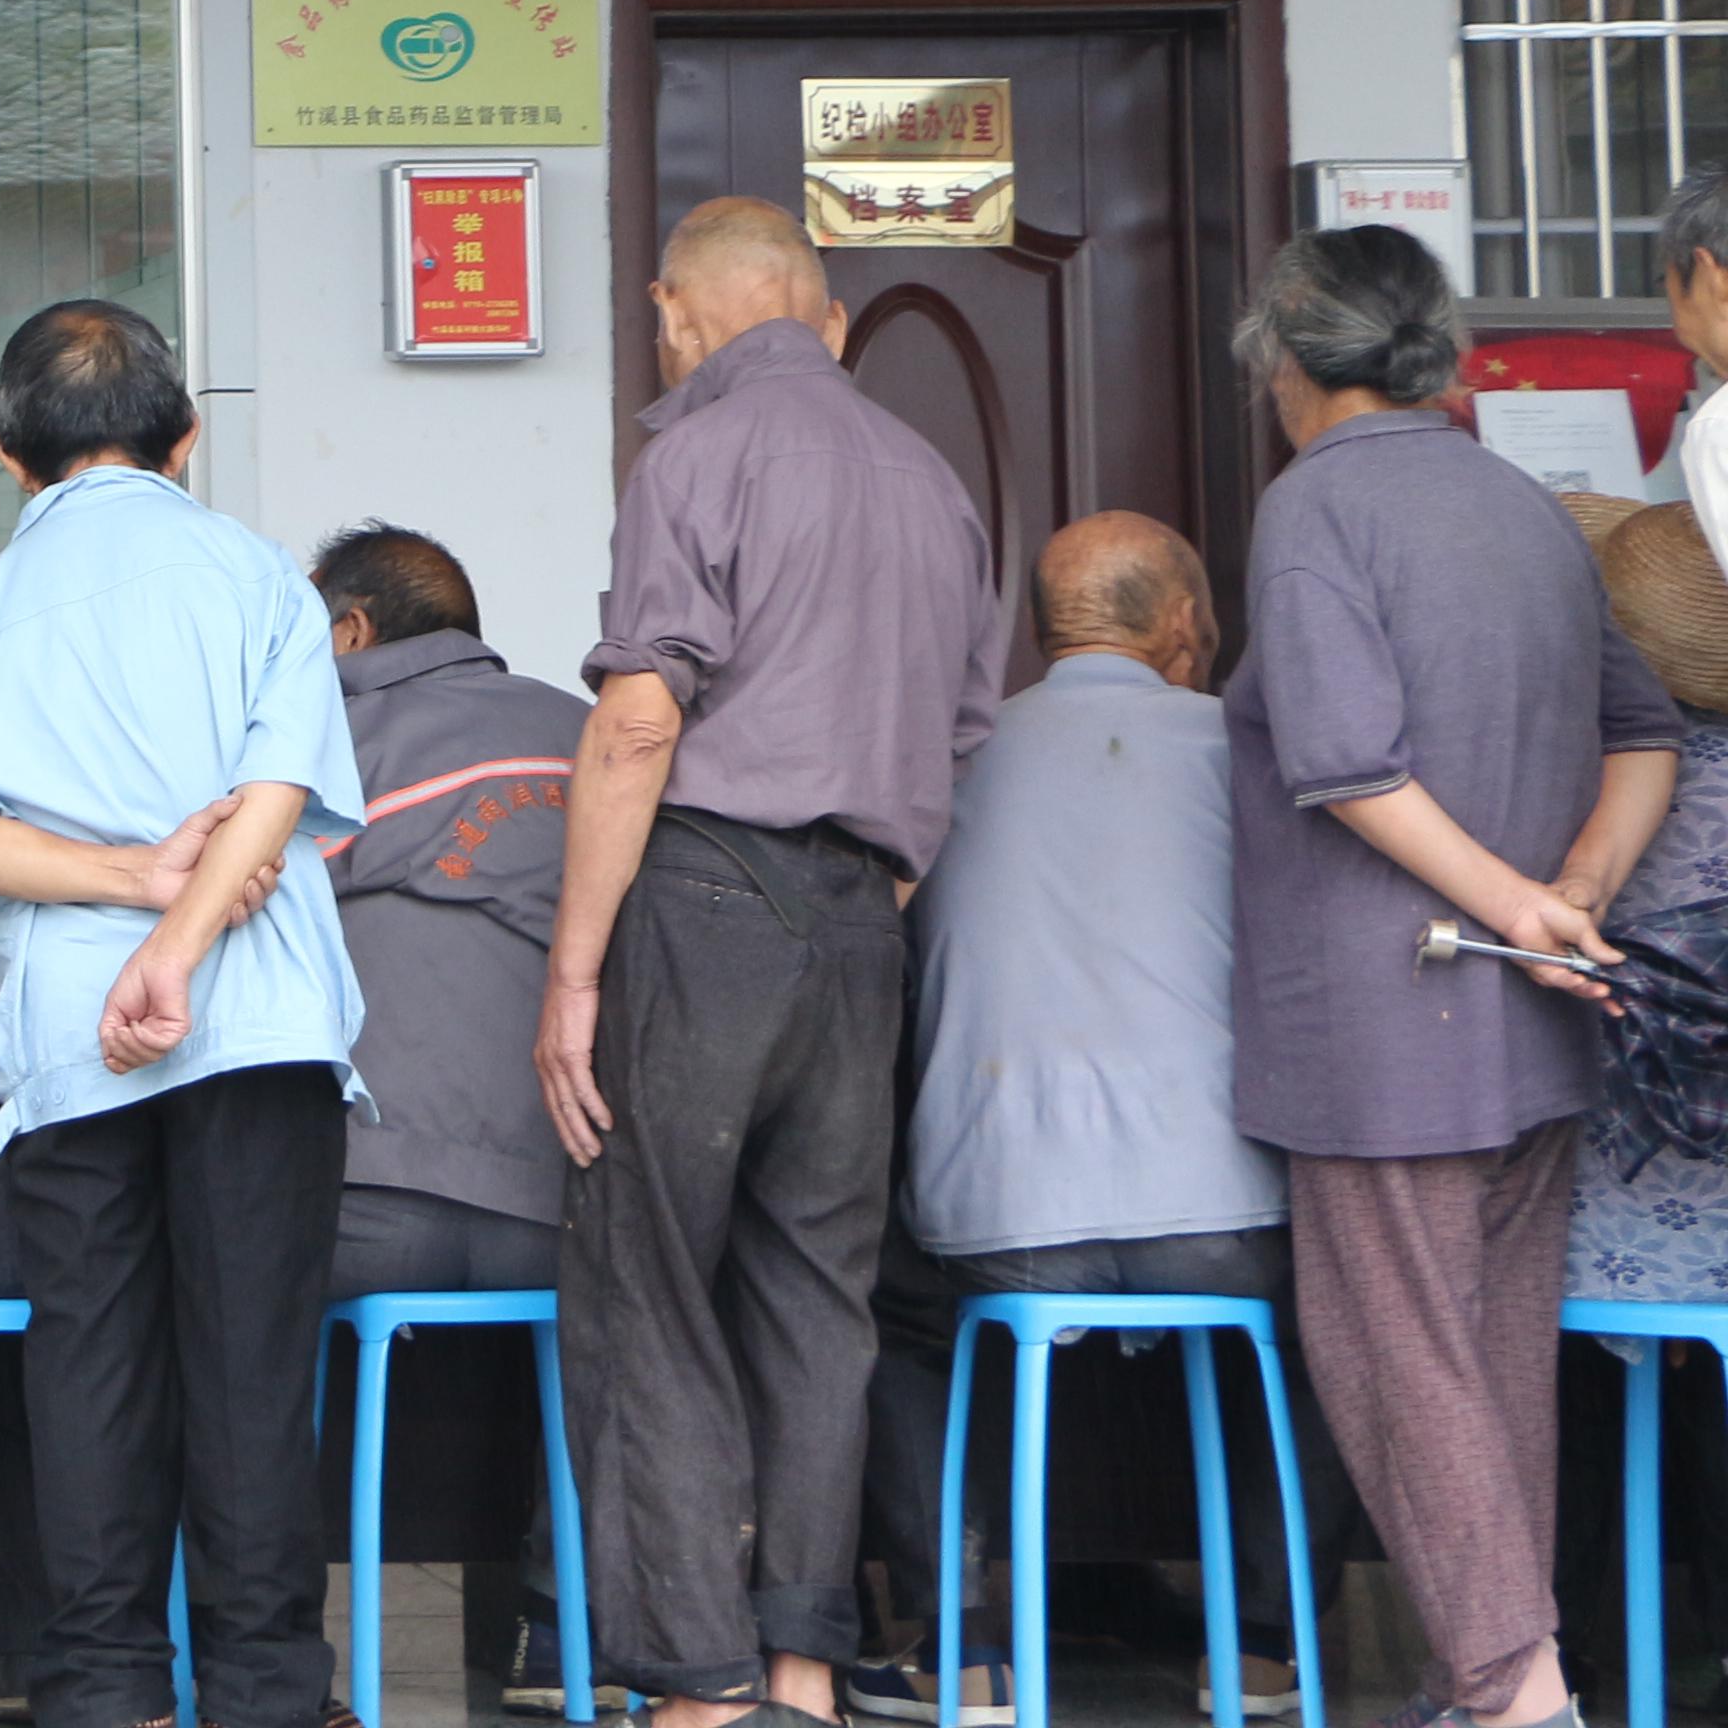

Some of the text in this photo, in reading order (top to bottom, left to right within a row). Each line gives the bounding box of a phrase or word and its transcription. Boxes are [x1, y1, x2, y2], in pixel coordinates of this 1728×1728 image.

[296, 105, 563, 127] 竹溪县食品药品监督管理局
[821, 101, 994, 142] 纪检小组办公室
[847, 184, 975, 223] 档案室
[452, 213, 485, 292] 举报箱
